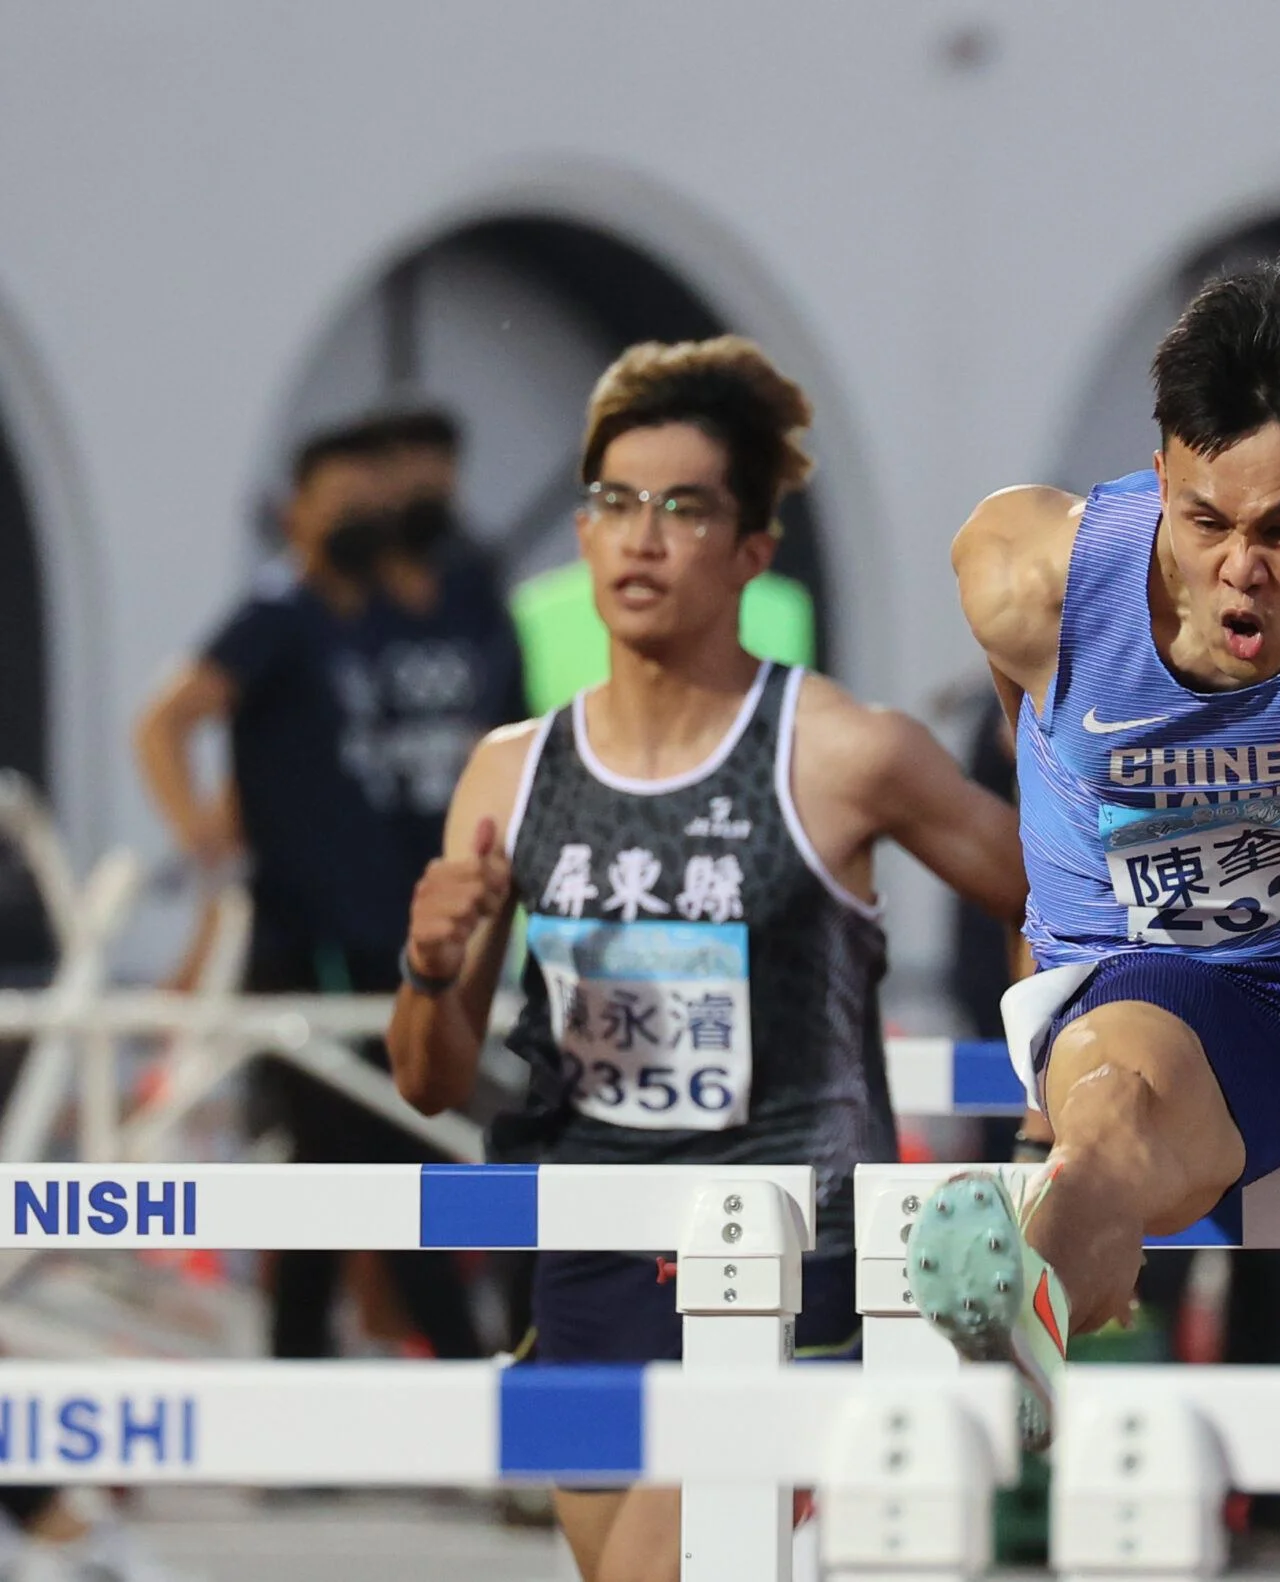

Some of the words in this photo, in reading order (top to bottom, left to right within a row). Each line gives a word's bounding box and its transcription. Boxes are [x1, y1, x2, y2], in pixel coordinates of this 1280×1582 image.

[539, 843, 744, 924] 屏東縣
[14, 1181, 197, 1235] NISHI
[0, 1395, 196, 1466] ISHI
